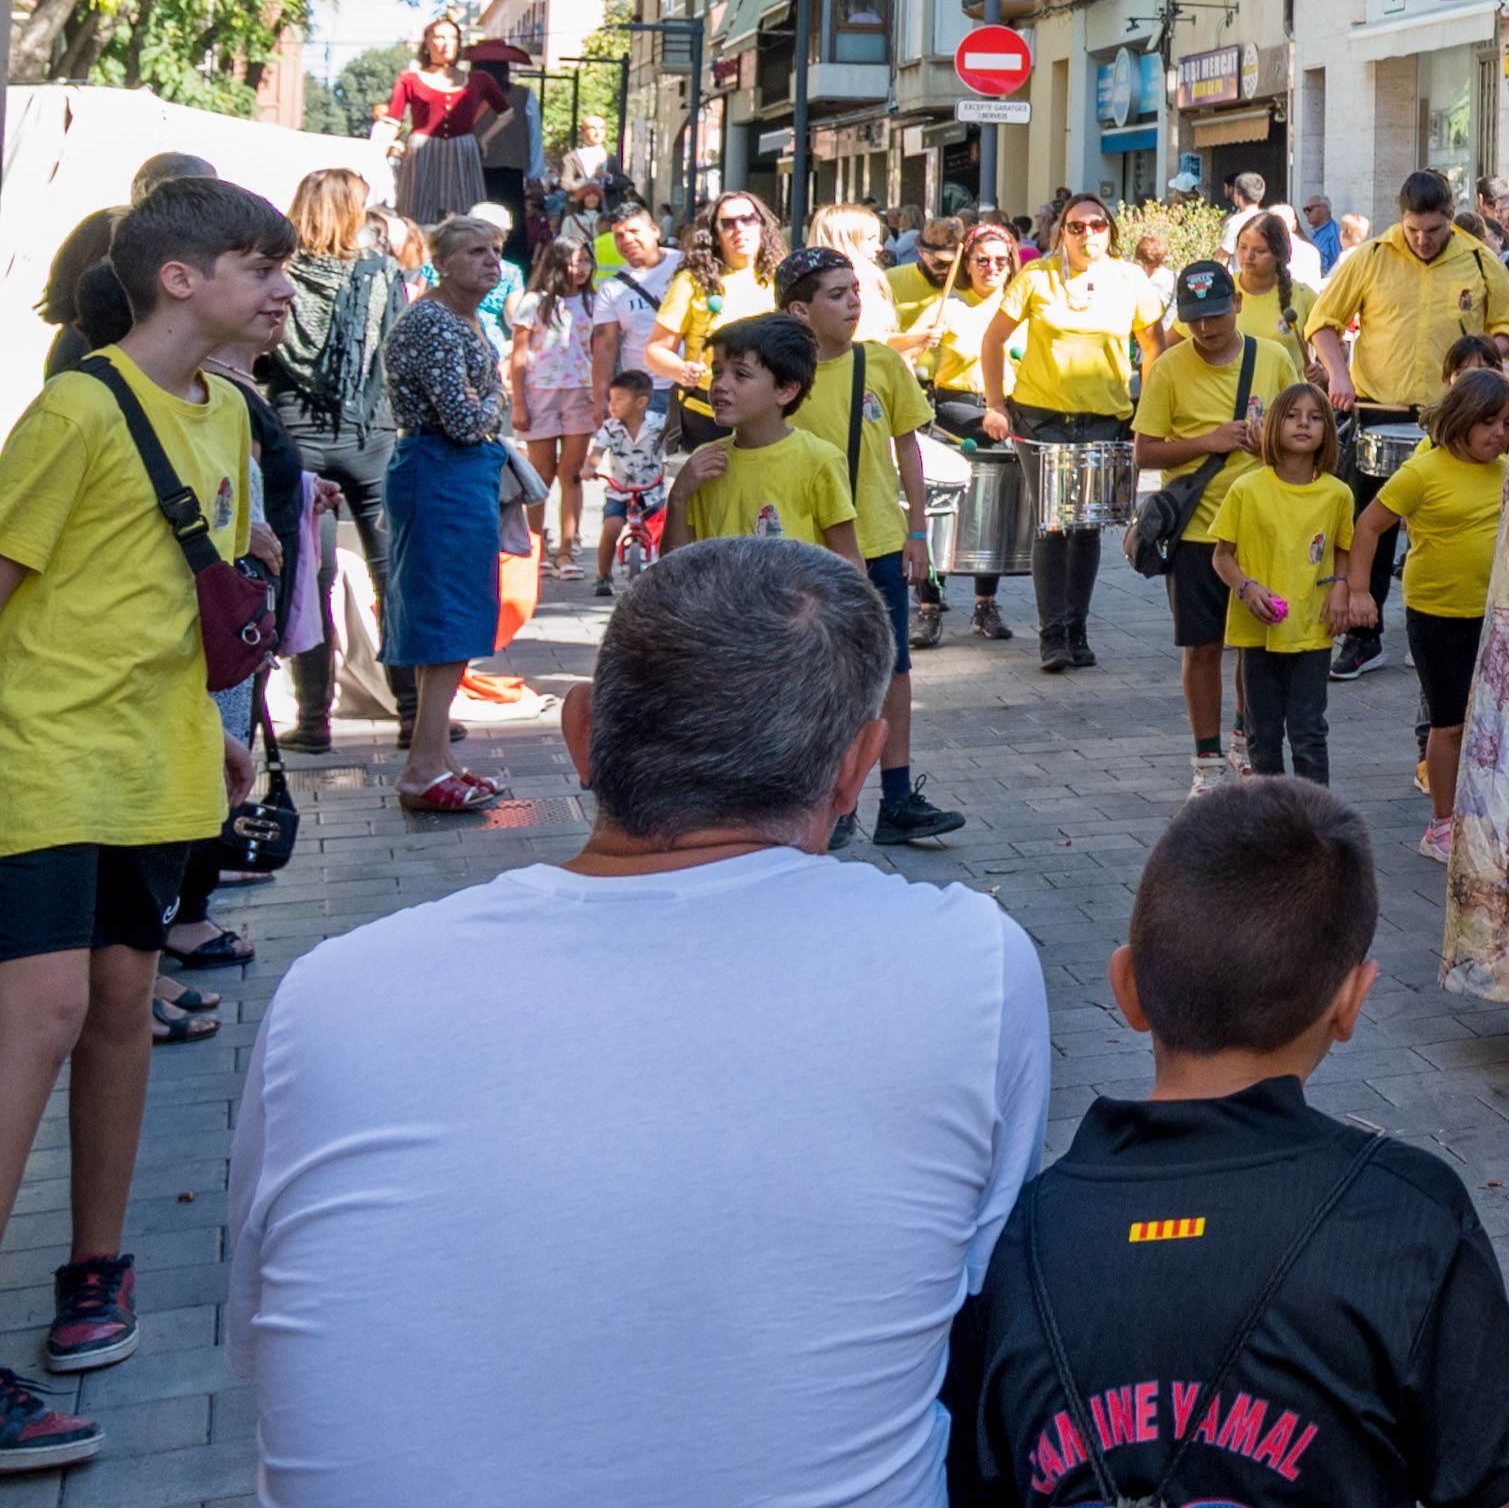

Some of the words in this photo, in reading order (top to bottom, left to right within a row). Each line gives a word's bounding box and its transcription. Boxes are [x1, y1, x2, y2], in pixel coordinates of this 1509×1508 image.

[1201, 51, 1238, 80] MERCAT
[964, 103, 992, 111] EXCEPTE
[994, 104, 1028, 112] GARATGES
[1171, 1380, 1319, 1483] YAMAL
